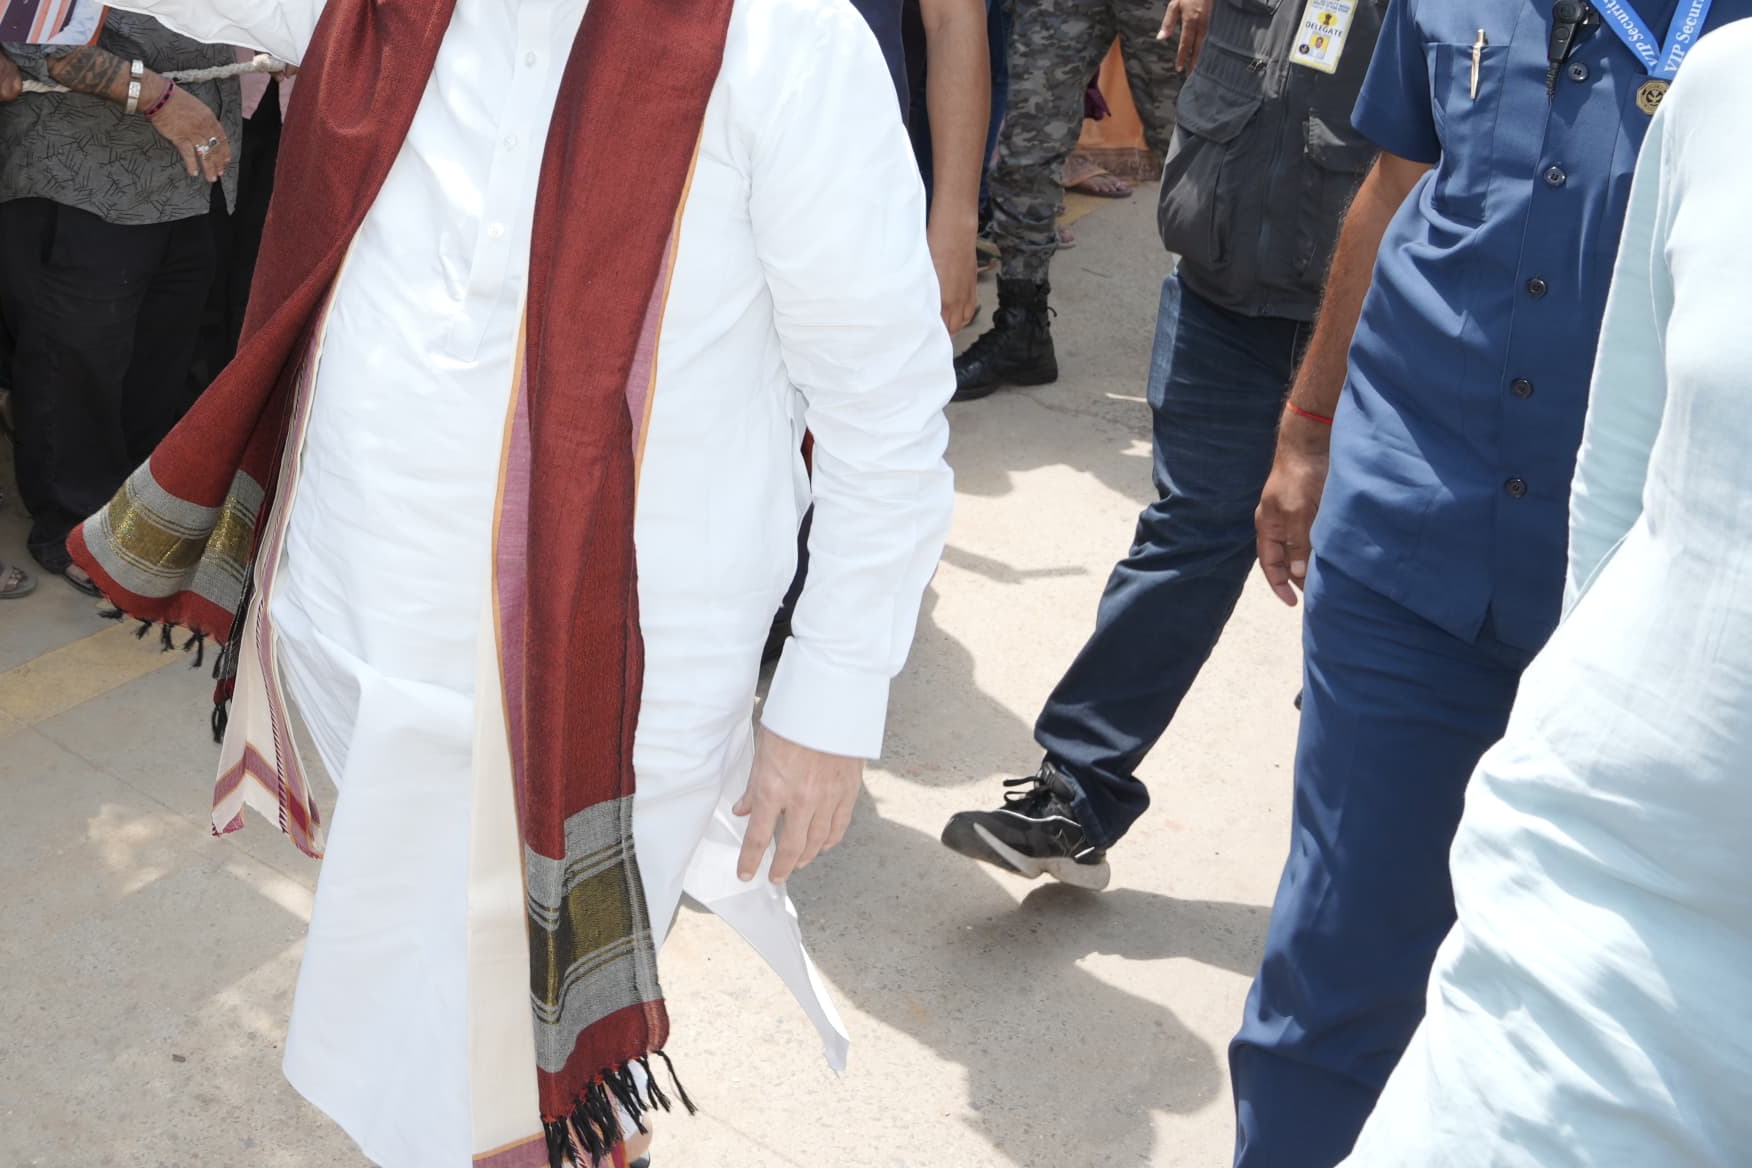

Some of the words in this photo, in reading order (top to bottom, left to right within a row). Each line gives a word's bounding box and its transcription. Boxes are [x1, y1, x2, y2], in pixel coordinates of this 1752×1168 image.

[1306, 21, 1343, 38] DELEGATE
[1636, 43, 1658, 68] VIP
[1664, 44, 1687, 73] VIP
